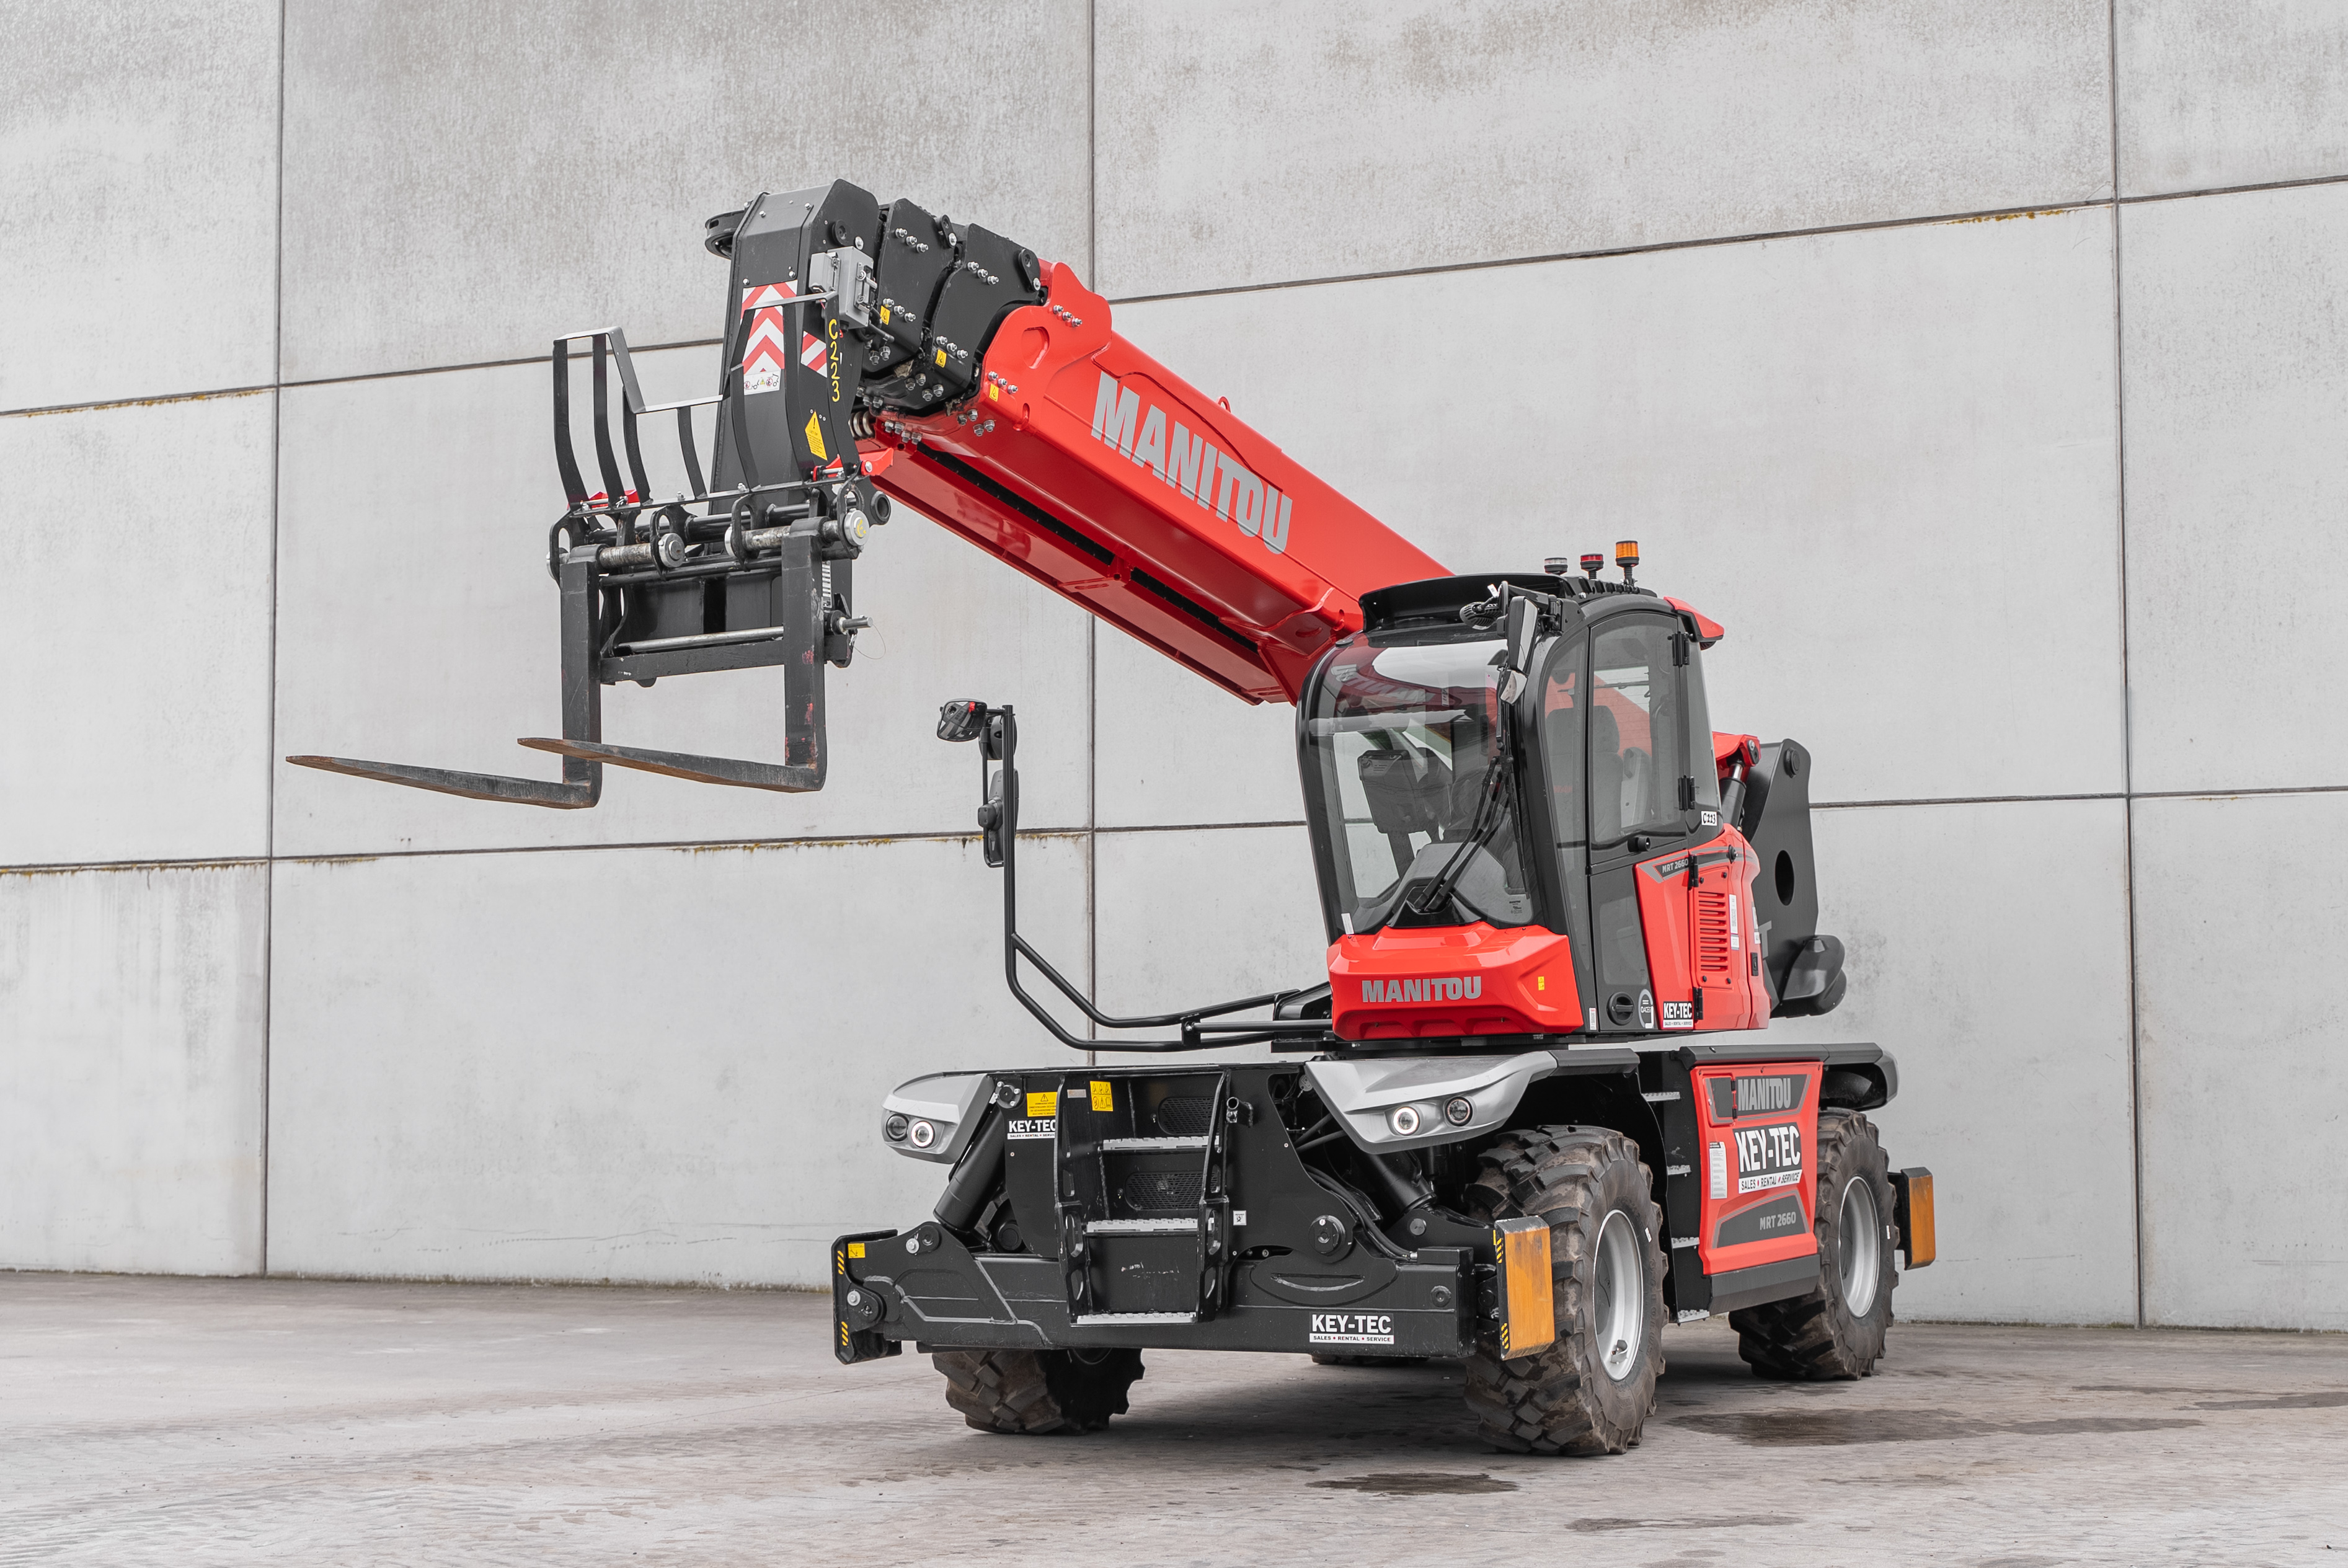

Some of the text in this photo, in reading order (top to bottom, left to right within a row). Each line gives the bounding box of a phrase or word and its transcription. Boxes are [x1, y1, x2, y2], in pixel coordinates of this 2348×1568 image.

[828, 319, 840, 402] C223
[1091, 370, 1293, 554] MANITOU
[1703, 813, 1716, 824] C223
[1662, 858, 1688, 874] MRT 2660
[1362, 976, 1481, 1003] MANITOU
[1664, 1003, 1692, 1019] KEY-TEC
[1737, 1078, 1791, 1111] MANITOU
[1009, 1119, 1056, 1133] KEY-TEC
[1734, 1125, 1801, 1172] KEY-TEC
[1741, 1171, 1800, 1190] SALES RENTAL SERVICE
[1760, 1211, 1796, 1230] MRT 2660
[1312, 1314, 1391, 1334] KEY-TEC
